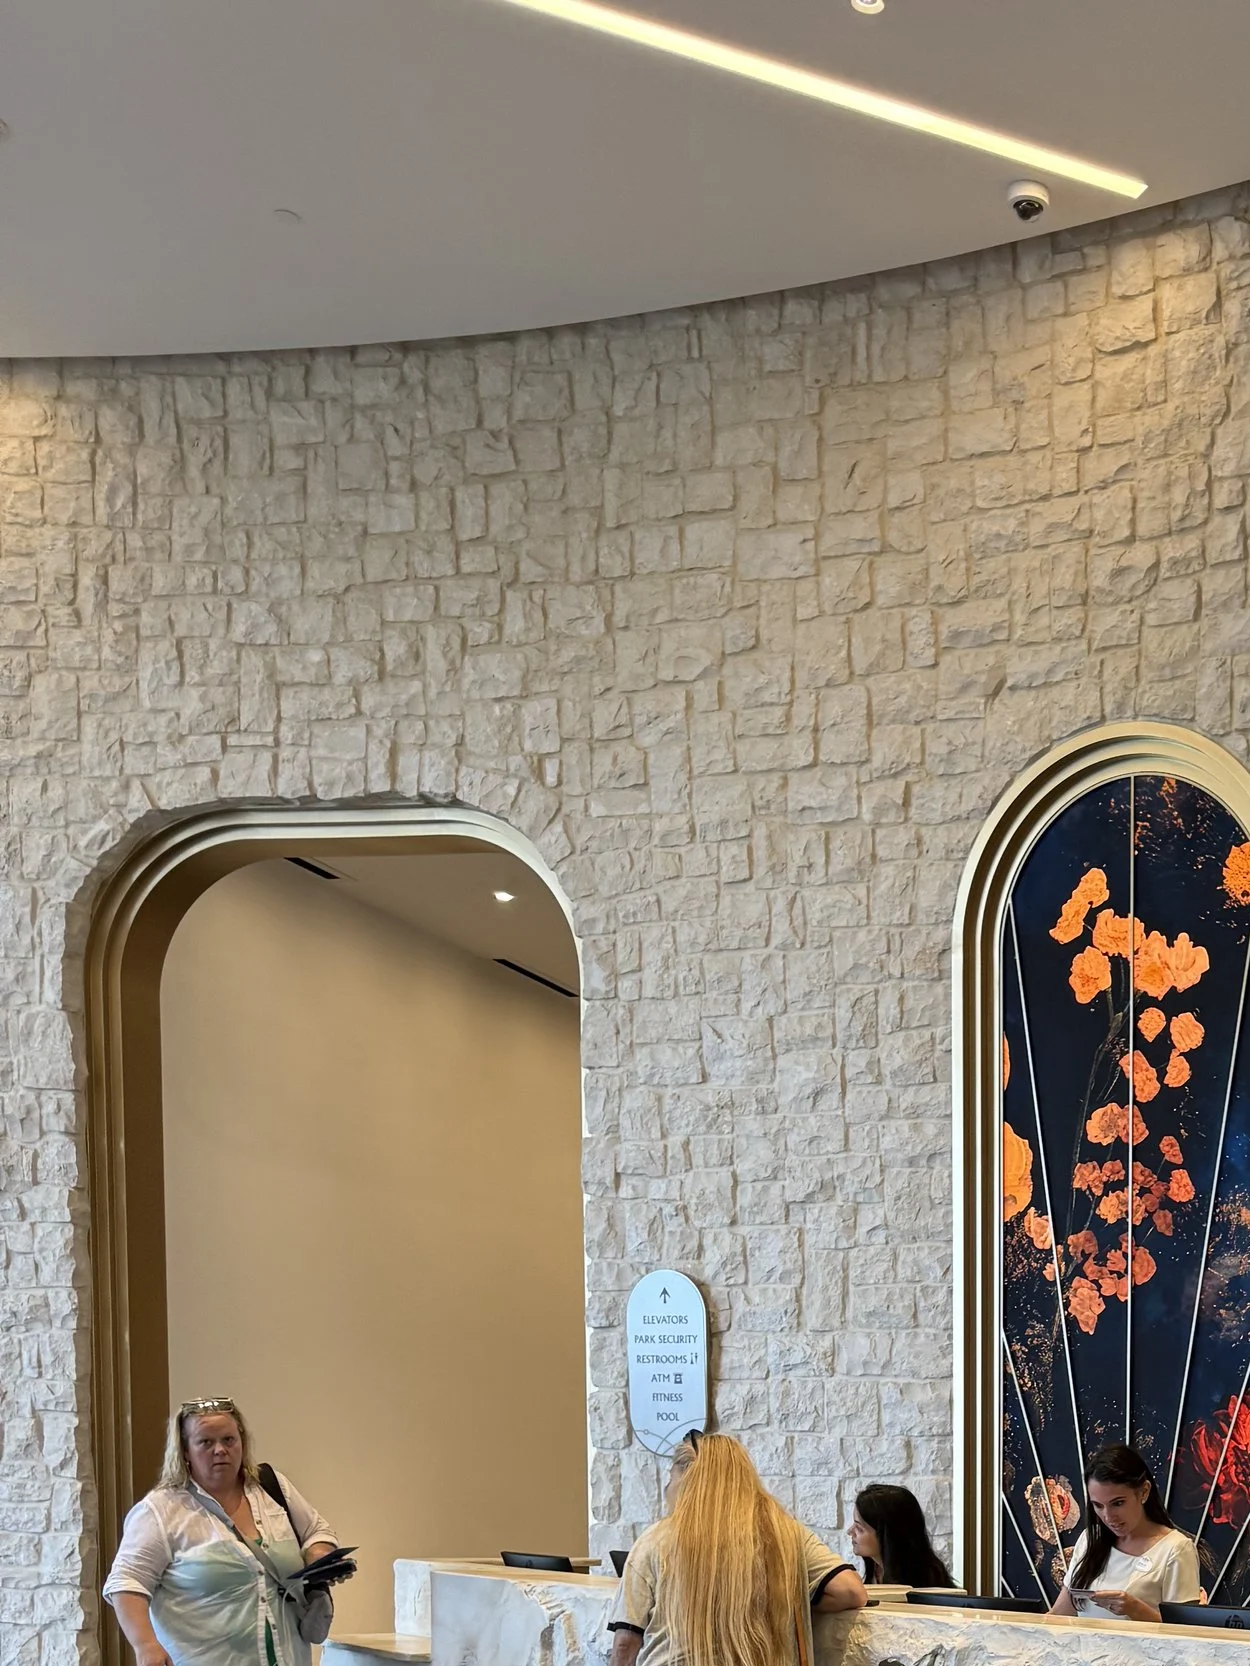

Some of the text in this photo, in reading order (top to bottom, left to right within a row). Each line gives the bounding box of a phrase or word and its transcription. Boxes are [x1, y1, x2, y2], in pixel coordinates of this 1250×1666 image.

[642, 1314, 689, 1325] ELEVATORS
[634, 1334, 698, 1345] PARK SECURITY
[636, 1354, 688, 1365] RESTROOMS
[650, 1373, 671, 1384] ATM
[652, 1392, 683, 1403] FITNESS
[656, 1412, 679, 1422] POOL
